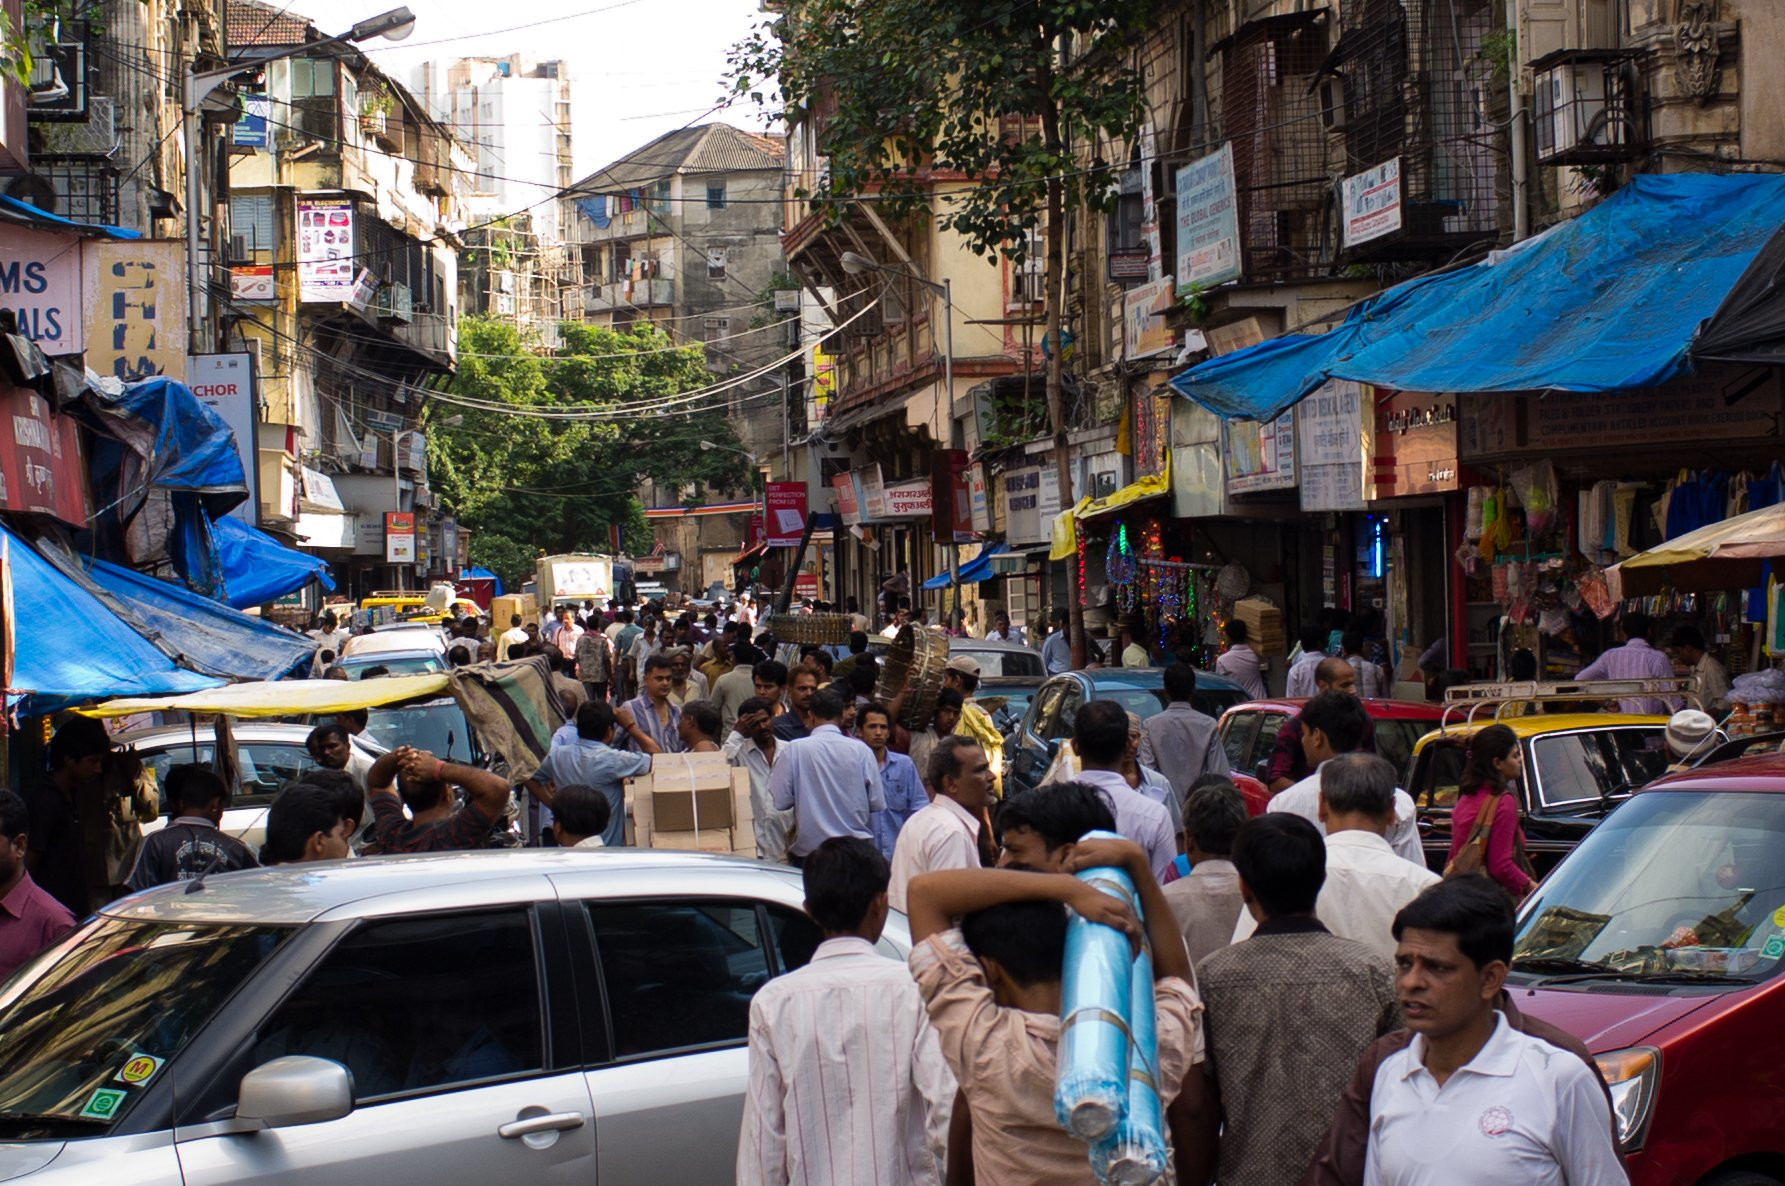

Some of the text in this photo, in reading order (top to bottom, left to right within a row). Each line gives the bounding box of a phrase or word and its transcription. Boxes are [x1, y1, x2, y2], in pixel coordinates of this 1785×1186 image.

[1191, 206, 1208, 224] GLOBAL
[1, 307, 62, 342] ALS
[189, 383, 238, 398] CHOR
[129, 1060, 150, 1075] M
